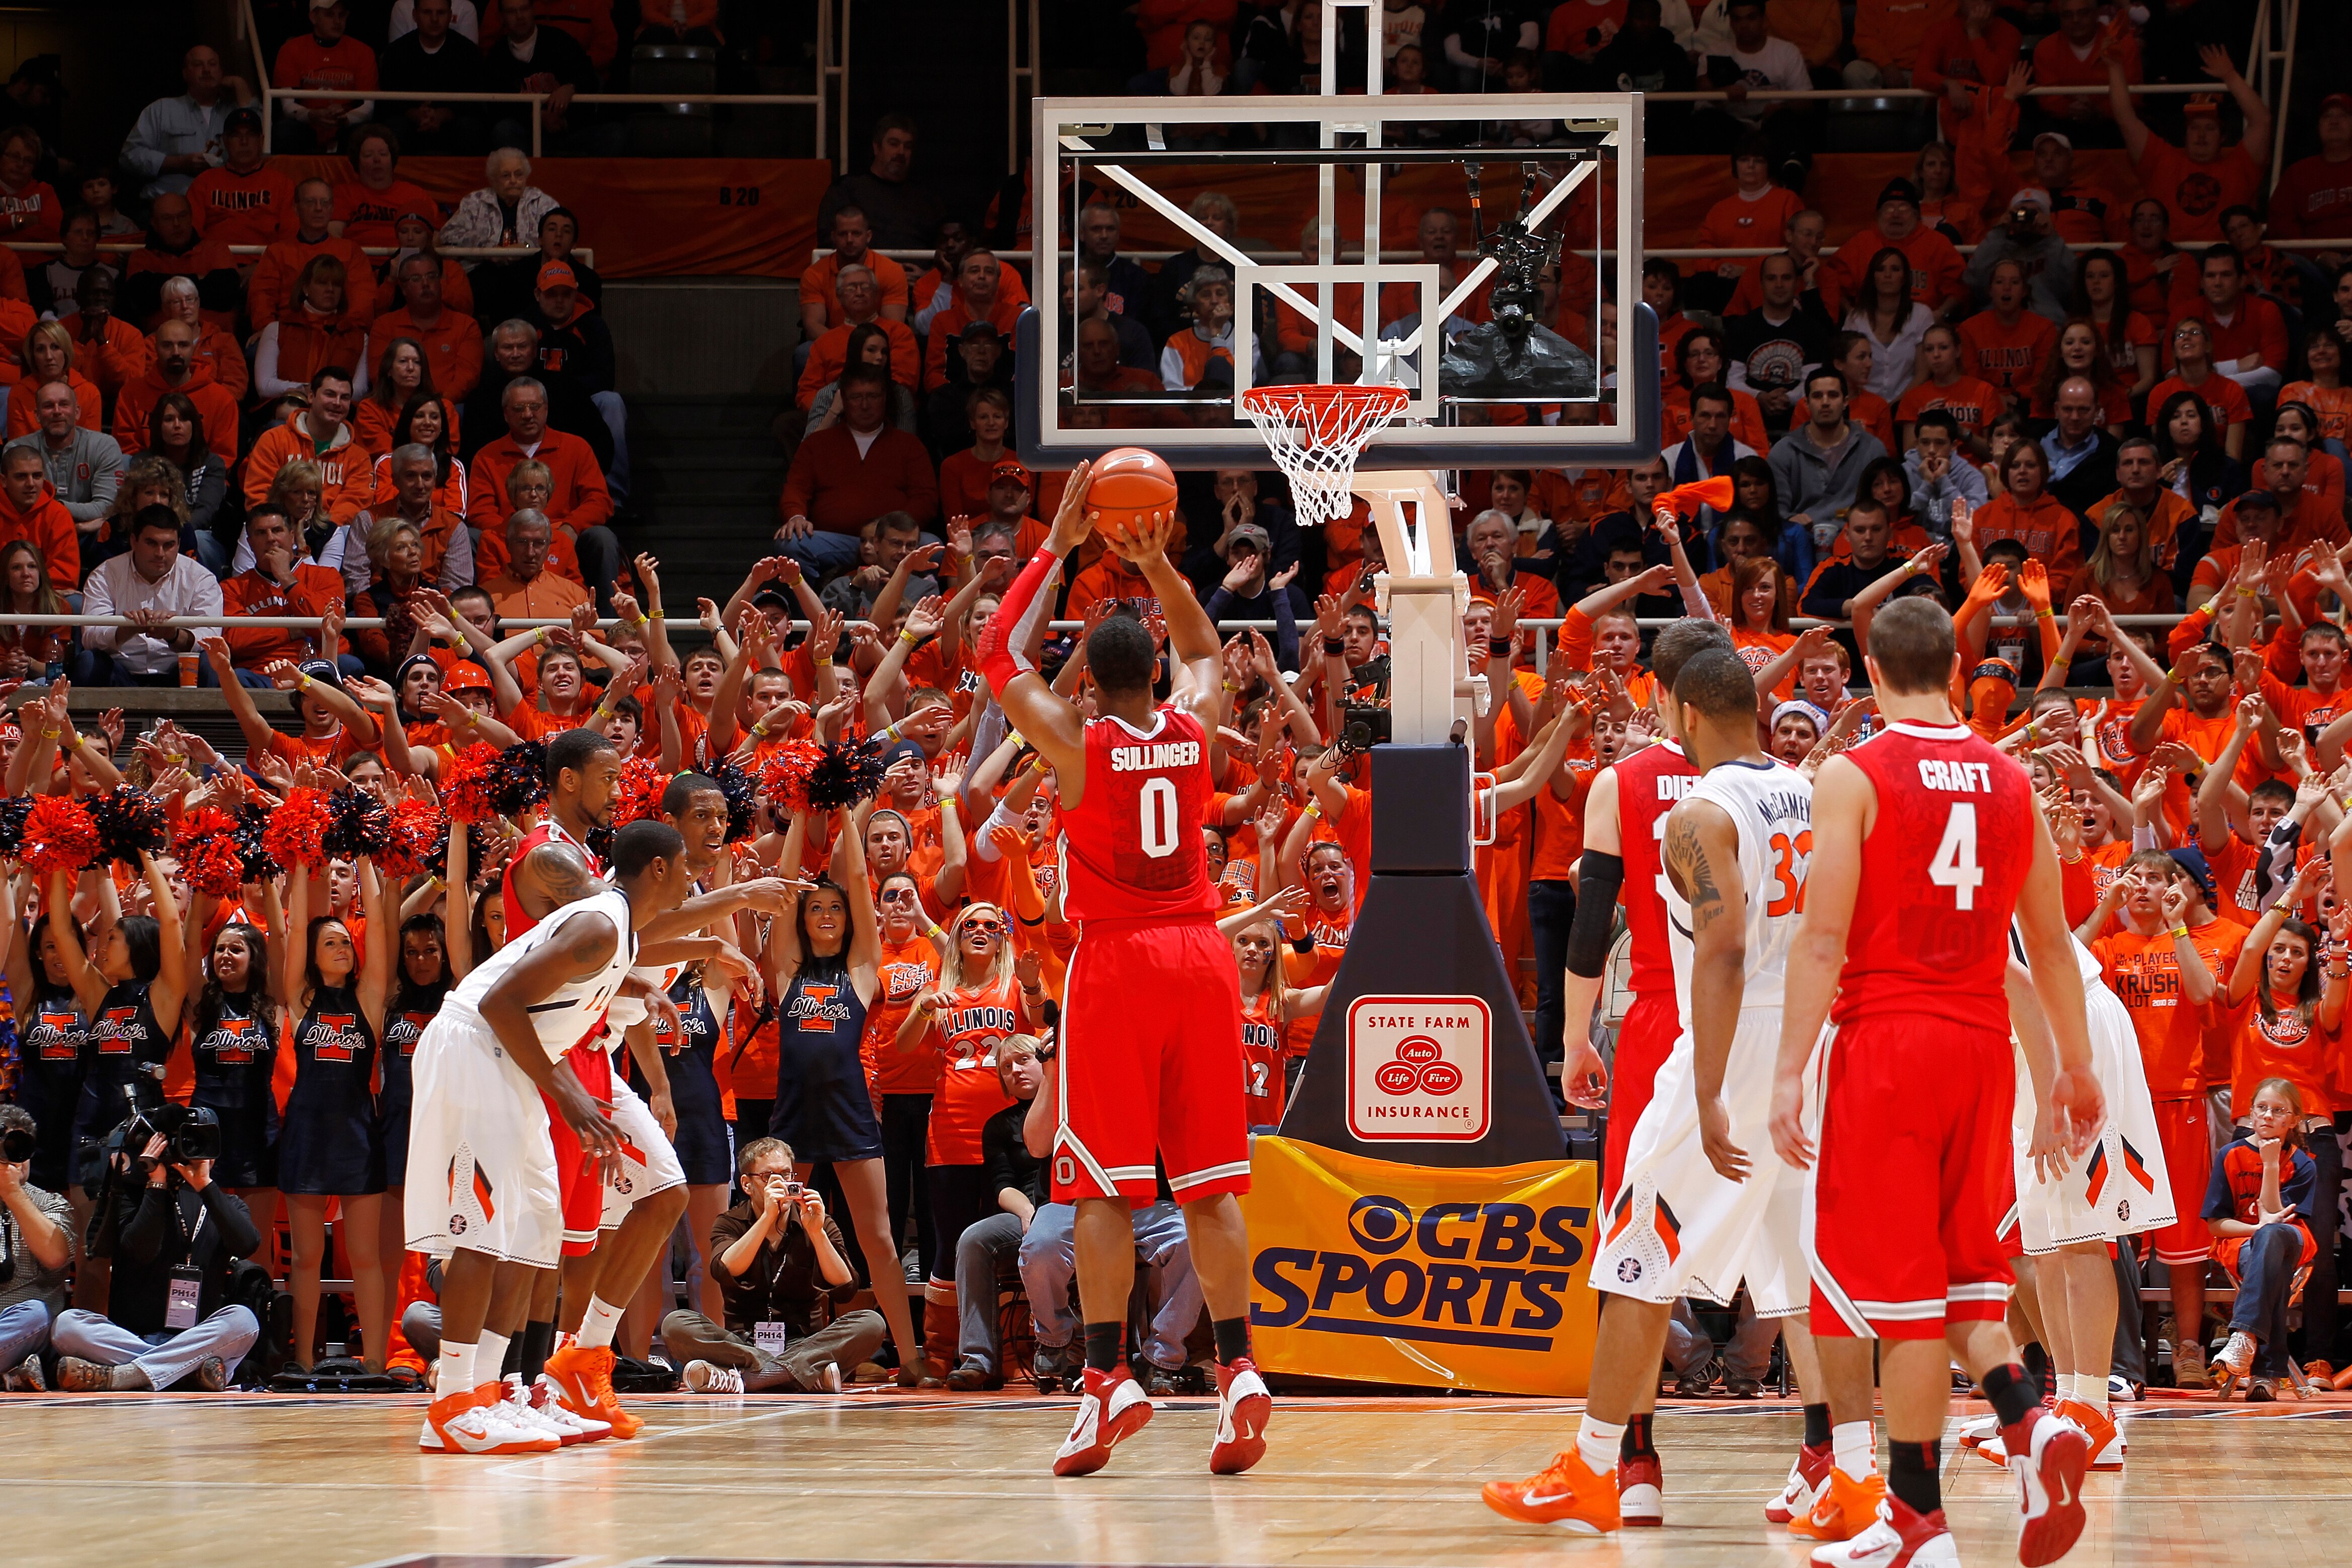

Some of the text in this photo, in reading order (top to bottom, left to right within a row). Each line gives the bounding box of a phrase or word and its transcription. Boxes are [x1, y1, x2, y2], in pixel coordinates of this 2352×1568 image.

[211, 189, 271, 210] ILLINOIS
[720, 187, 759, 206] B 20
[77, 463, 91, 480] O
[1110, 740, 1200, 771] SULLINGER
[1918, 758, 1990, 794] CRAFT
[1140, 777, 1179, 859] 0
[1929, 803, 1983, 910] 4
[2134, 952, 2177, 965] PLAYER
[2141, 965, 2160, 974] JUST
[2116, 974, 2179, 993] KRUSH
[787, 997, 851, 1020] Illinois
[2128, 994, 2151, 1008] LOT
[87, 1021, 149, 1040] Illinois
[940, 1006, 1016, 1044] ILLINOIS
[1368, 1016, 1470, 1029] STATE FARM
[26, 1025, 90, 1046] Illinois
[200, 1030, 269, 1050] Illinois
[302, 1025, 366, 1049] Illinois
[953, 1033, 1000, 1073] 22
[1405, 1048, 1433, 1058] Auto
[1386, 1073, 1451, 1085] Life Fire
[1367, 1106, 1470, 1118] INSURANCE
[1416, 1201, 1591, 1267] CBS
[171, 1289, 196, 1298] PH14
[1250, 1246, 1570, 1330] SPORTS
